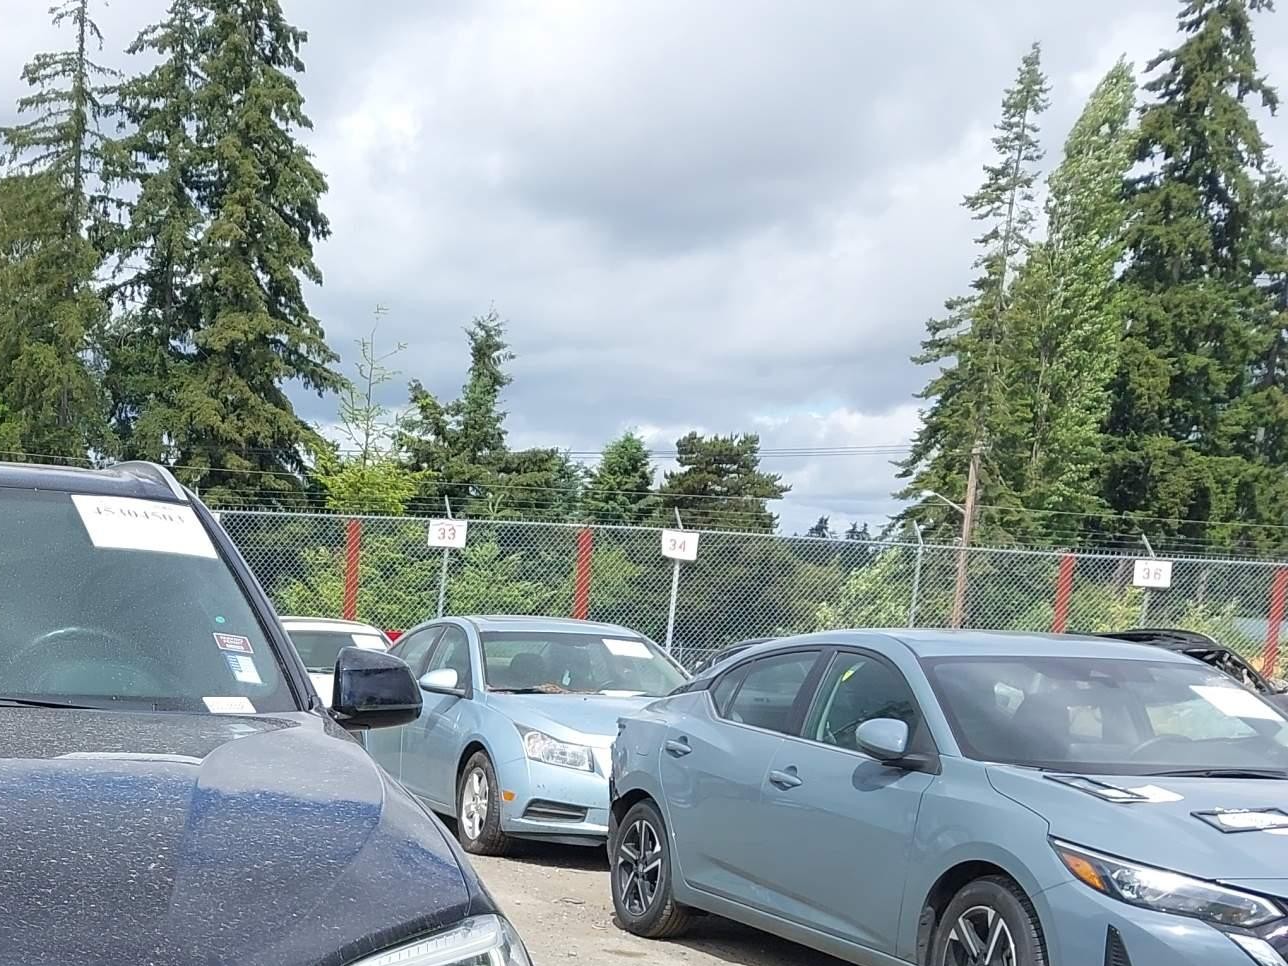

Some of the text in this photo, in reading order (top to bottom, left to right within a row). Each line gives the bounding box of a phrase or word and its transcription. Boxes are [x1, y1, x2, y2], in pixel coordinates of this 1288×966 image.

[437, 526, 456, 540] 33
[669, 539, 685, 552] 34
[1143, 568, 1162, 580] 36
